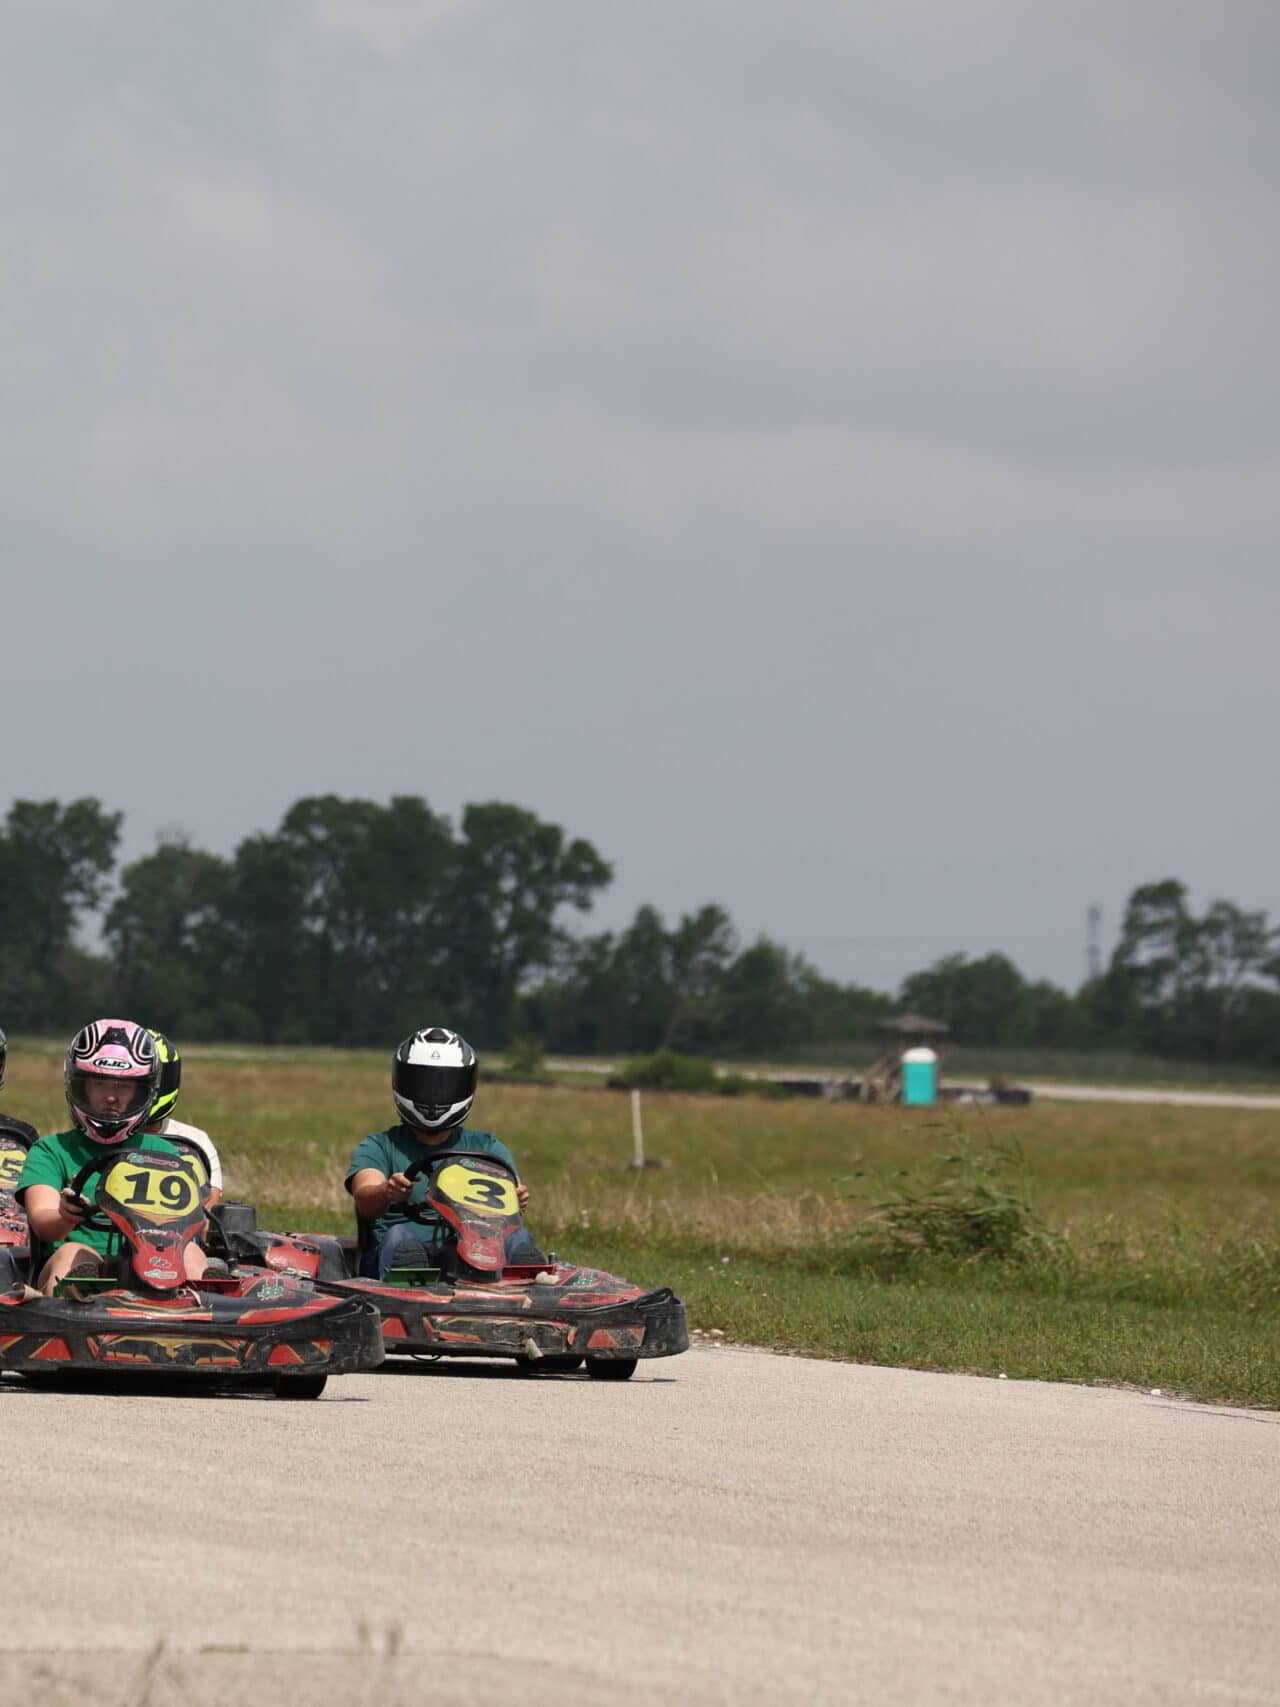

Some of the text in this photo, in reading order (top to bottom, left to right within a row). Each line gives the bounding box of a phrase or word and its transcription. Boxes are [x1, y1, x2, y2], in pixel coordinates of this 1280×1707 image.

[98, 1059, 127, 1068] HJC
[122, 1171, 192, 1211] 19
[463, 1178, 506, 1210] 3
